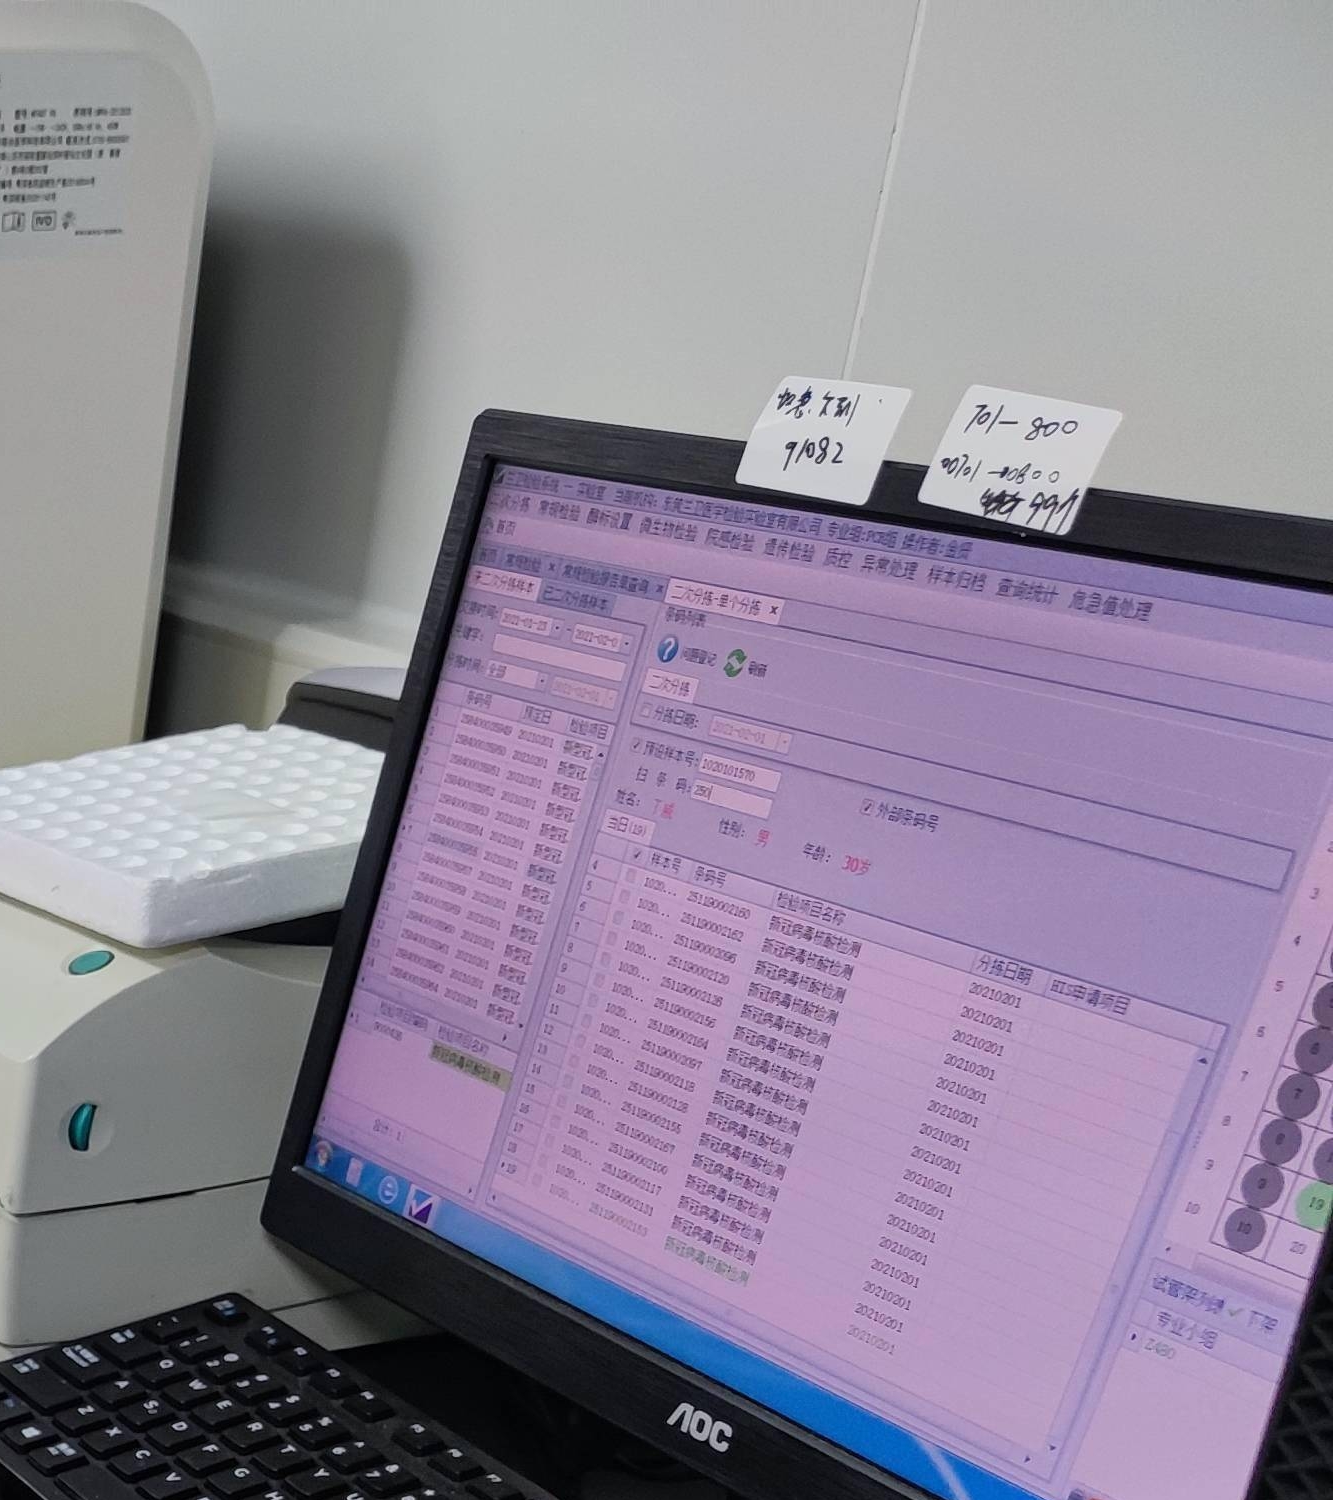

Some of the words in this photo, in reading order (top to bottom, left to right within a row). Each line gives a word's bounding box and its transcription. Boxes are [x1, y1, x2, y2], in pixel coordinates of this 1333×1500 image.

[924, 564, 988, 593] 样本归档
[994, 576, 1061, 606] 查询统计
[1067, 589, 1155, 623] 危急值处理
[966, 980, 1024, 1010] 20210201
[958, 1004, 1015, 1035] 20210201
[949, 1028, 1006, 1059] 20210201
[941, 1051, 997, 1083] 20210201
[933, 1075, 989, 1106] 20210201
[924, 1098, 980, 1130] 20210201
[916, 1121, 971, 1153] 20210201
[908, 1144, 963, 1177] 20210201
[1152, 1306, 1220, 1352] 专业小组
[160, 1360, 173, 1368] Q
[189, 1380, 206, 1389] W
[78, 1406, 94, 1415] Z
[217, 1400, 232, 1409] E
[106, 1427, 121, 1436] X
[172, 1422, 187, 1430] D
[248, 1422, 262, 1431] R
[666, 1402, 733, 1452] AOC
[136, 1450, 150, 1458] C
[166, 1473, 180, 1481] V
[235, 1468, 249, 1477] G
